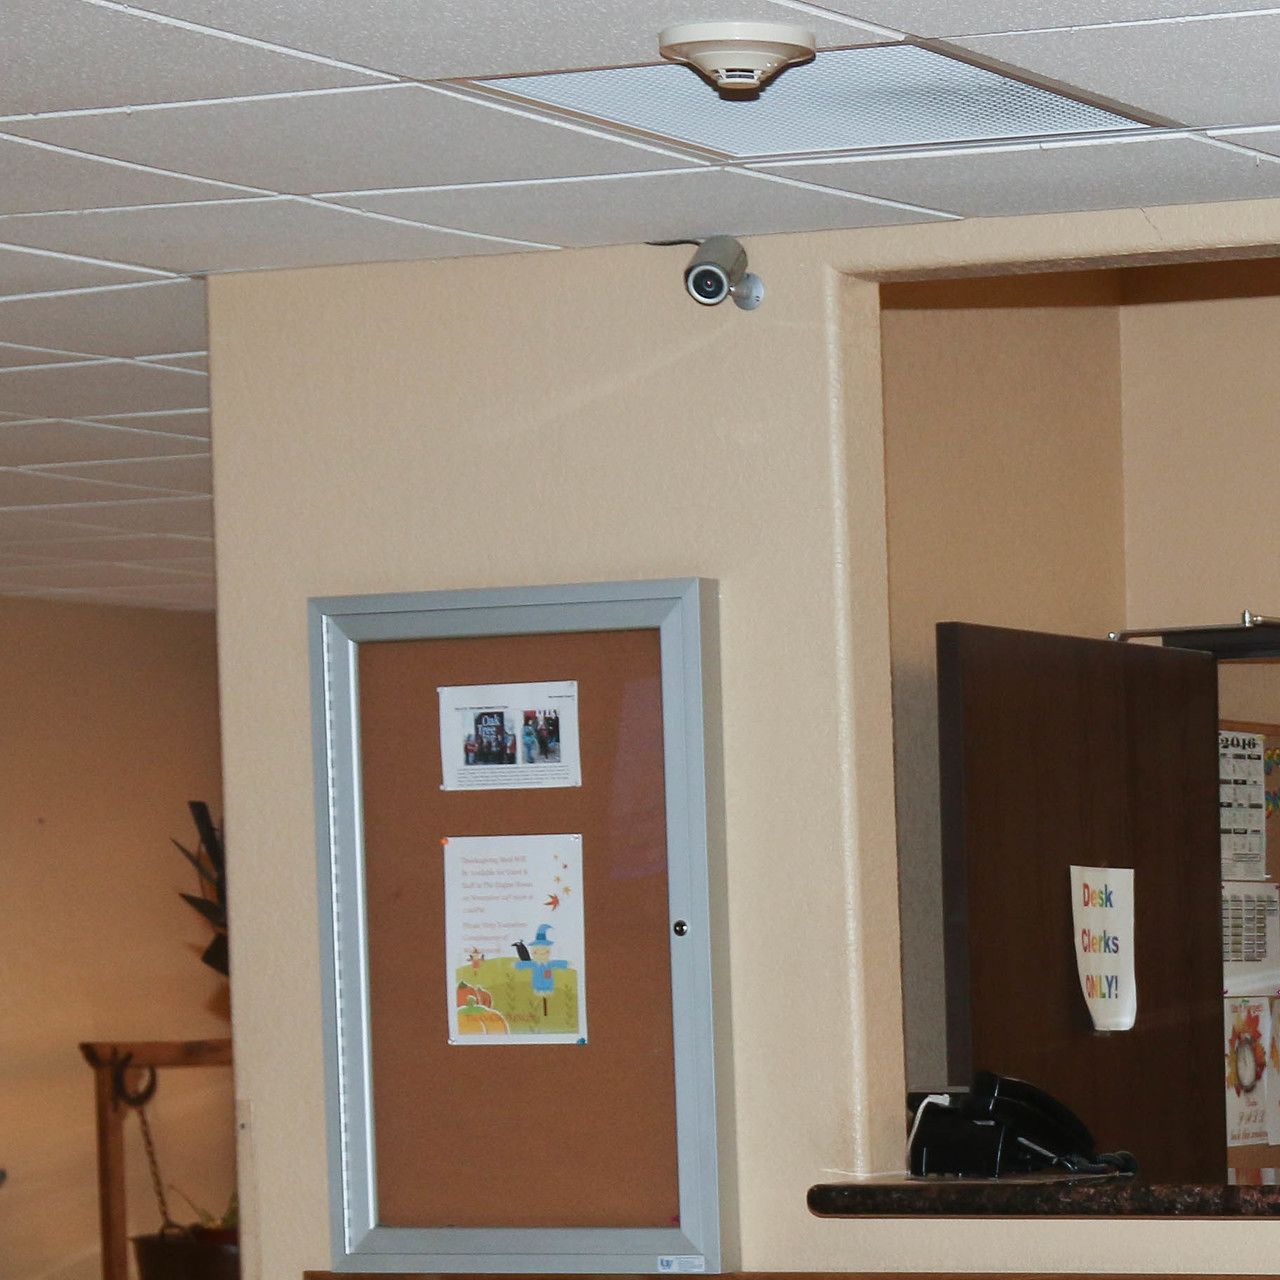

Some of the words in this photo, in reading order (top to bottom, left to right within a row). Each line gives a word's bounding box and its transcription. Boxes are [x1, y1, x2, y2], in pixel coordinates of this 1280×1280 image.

[1082, 882, 1114, 909] Desk
[1081, 928, 1119, 954] Clerks
[1085, 974, 1119, 999] ONLY!
